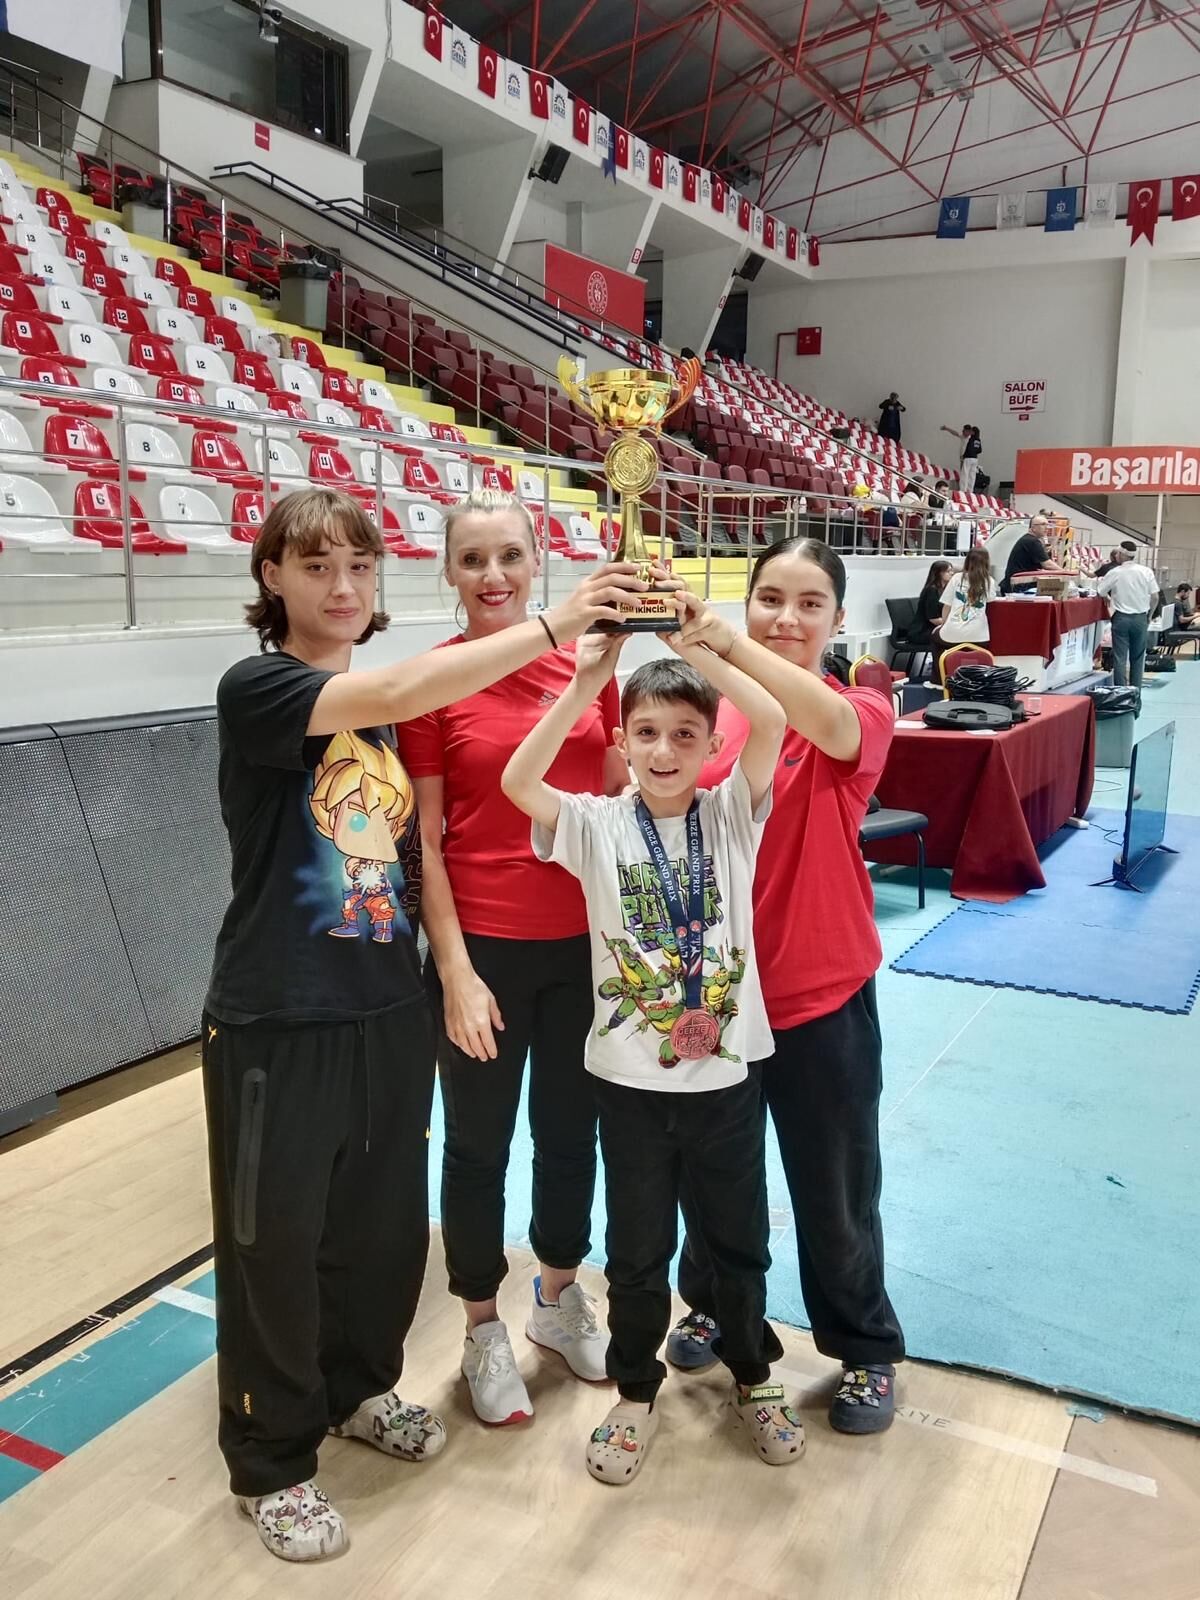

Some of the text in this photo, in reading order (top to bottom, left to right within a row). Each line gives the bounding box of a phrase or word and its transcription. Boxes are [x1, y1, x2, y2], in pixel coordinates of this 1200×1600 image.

[26, 234, 36, 242] 13
[76, 250, 85, 258] 14
[44, 264, 54, 274] 12
[96, 276, 105, 284] 13
[1, 287, 12, 297] 10
[144, 292, 152, 300] 14
[61, 300, 70, 310] 11
[118, 312, 128, 321] 12
[168, 320, 177, 328] 13
[20, 325, 28, 334] 9
[80, 334, 92, 344] 10
[215, 336, 224, 345] 14
[144, 348, 152, 358] 11
[196, 360, 206, 370] 12
[245, 368, 254, 376] 13
[109, 378, 117, 388] 9
[291, 382, 300, 390] 14
[331, 380, 338, 388] 15
[1005, 381, 1045, 392] SALON
[172, 386, 183, 396] 10
[1009, 392, 1039, 405] BÜFE
[228, 400, 236, 410] 11
[407, 424, 415, 432] 15
[71, 434, 79, 445] 7
[142, 442, 152, 452] 8
[208, 443, 215, 454] 9
[268, 450, 278, 460] 10
[320, 456, 329, 466] 11
[414, 470, 422, 478] 13
[1070, 451, 1200, 490] Başarıla
[454, 478, 462, 487] 14
[5, 494, 16, 507] 5
[96, 493, 105, 505] 6
[179, 503, 186, 514] 7
[250, 510, 258, 521] 8
[418, 512, 424, 520] 11
[690, 838, 700, 872] GRAND
[642, 820, 678, 902] GEBZE GRAND PRIX
[692, 874, 700, 896] PRIX
